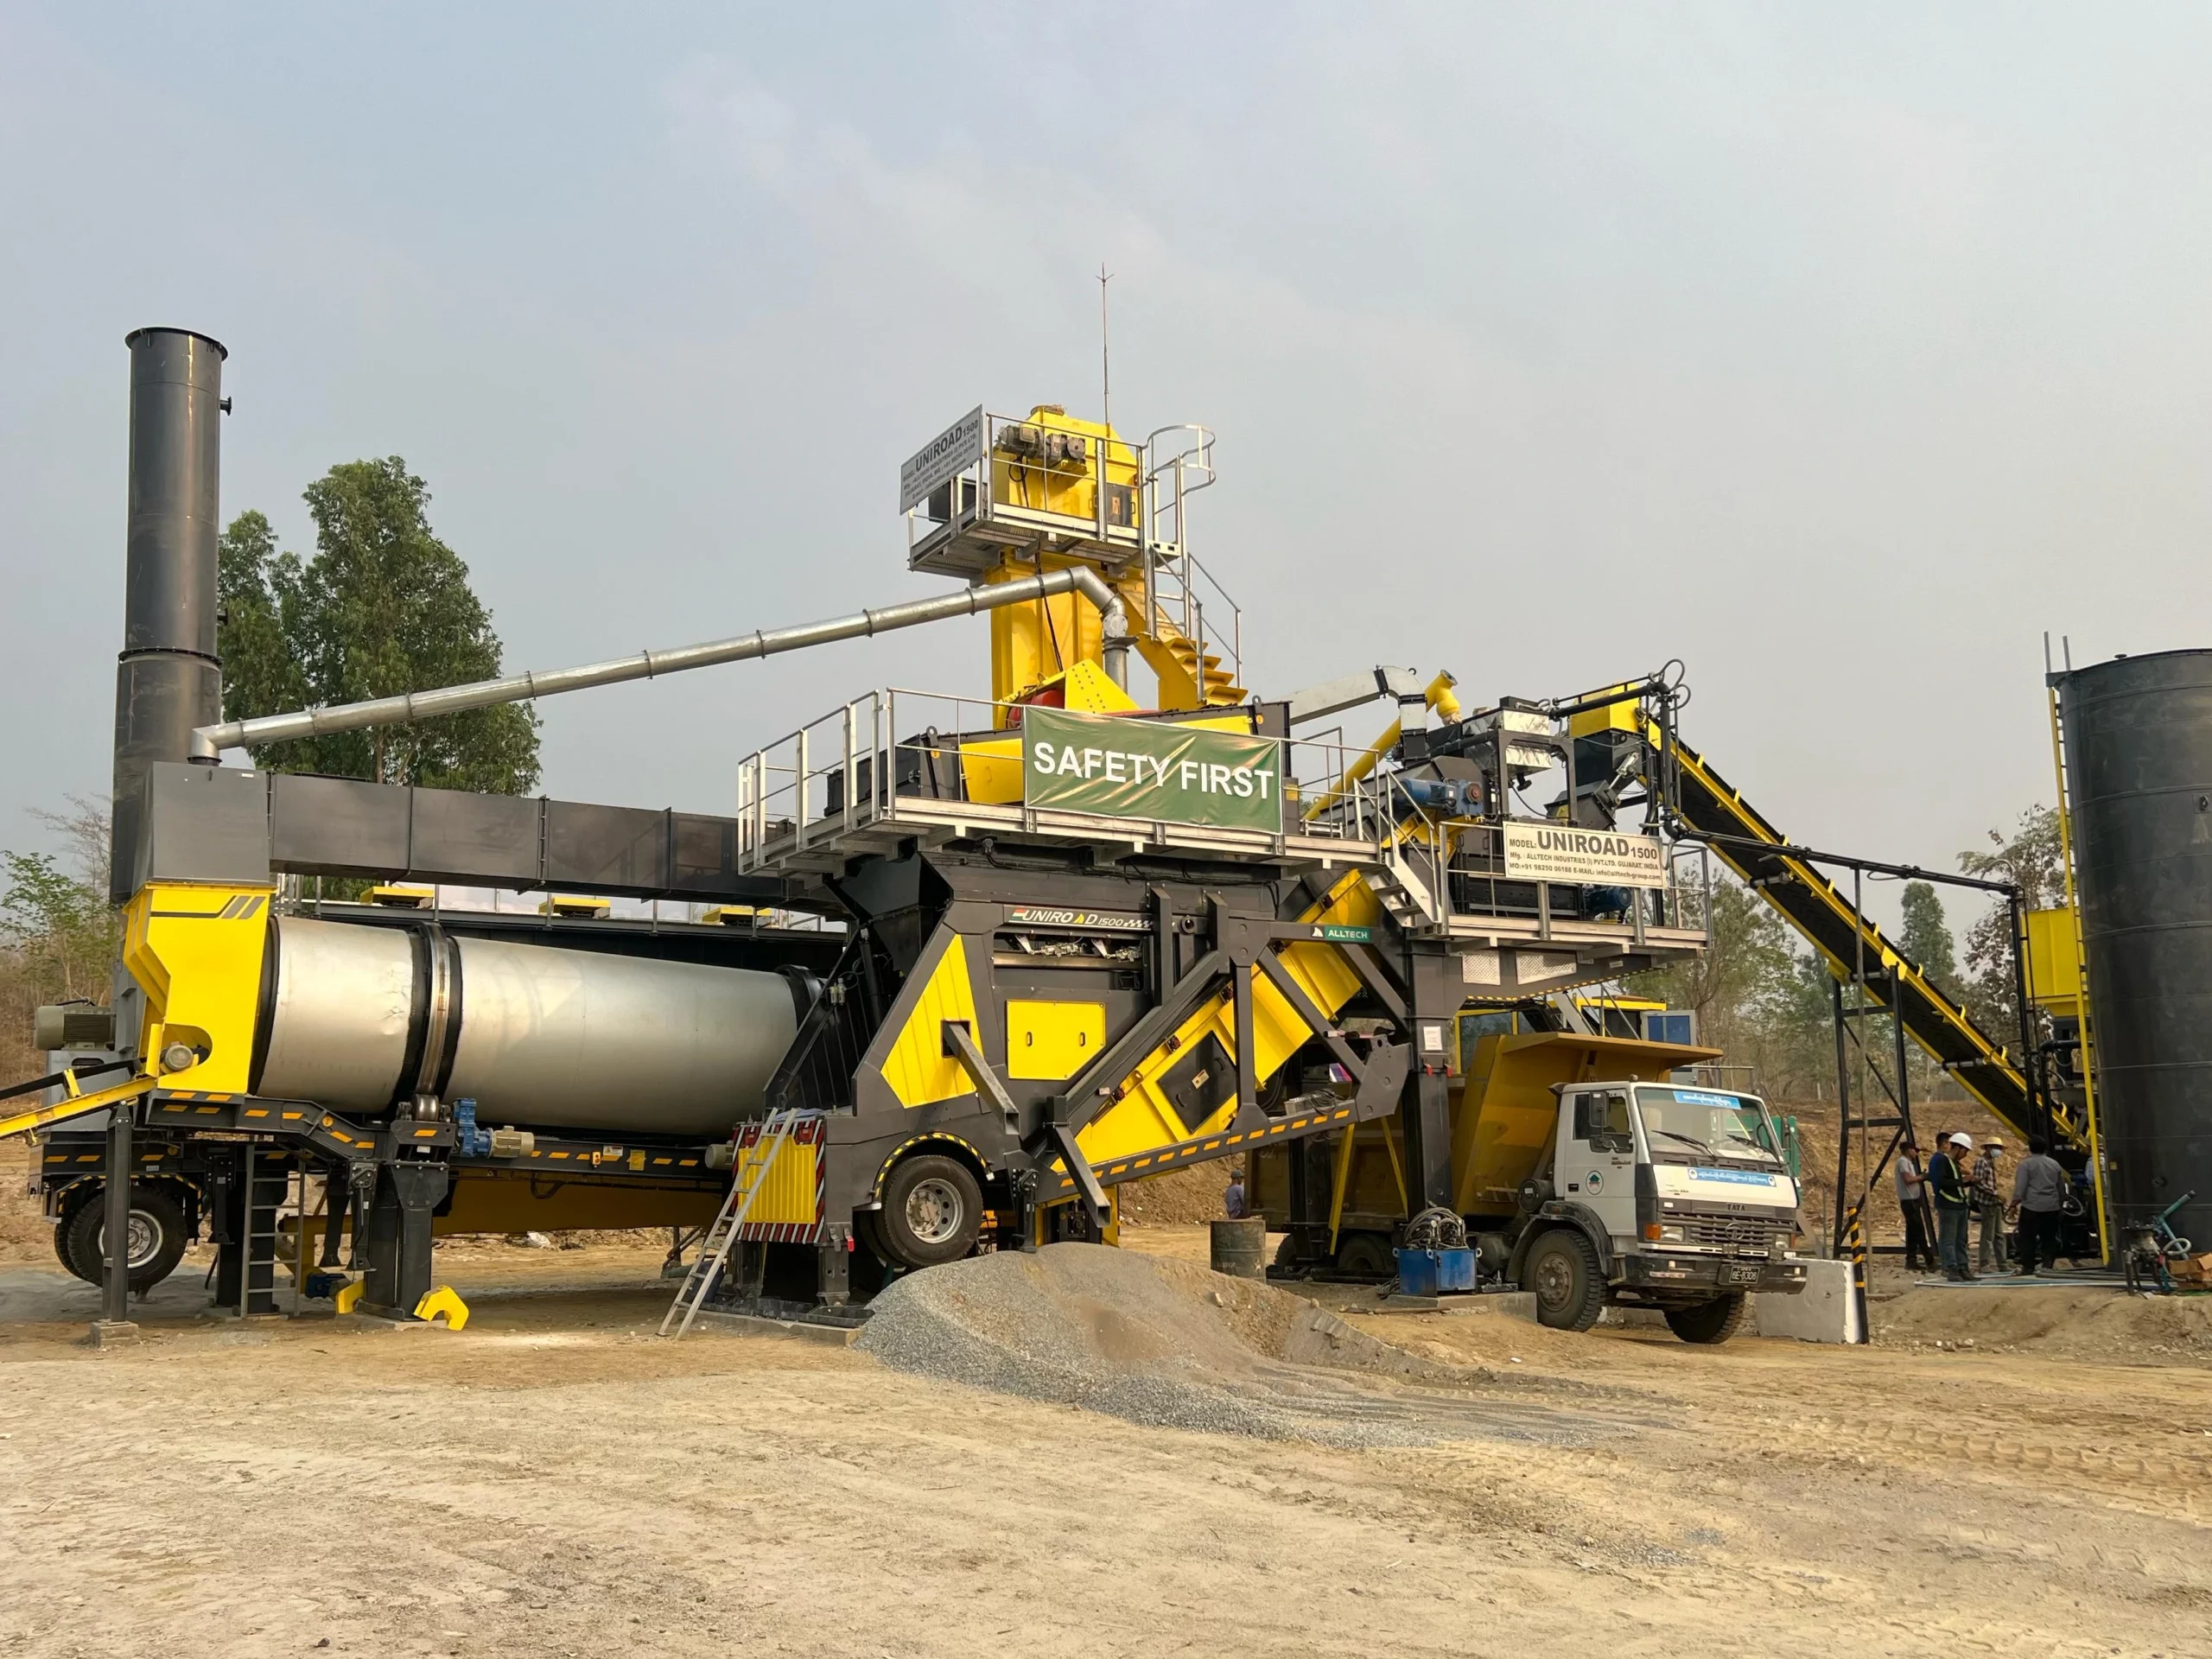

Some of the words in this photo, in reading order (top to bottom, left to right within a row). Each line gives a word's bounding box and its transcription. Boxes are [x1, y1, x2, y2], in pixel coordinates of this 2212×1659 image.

[916, 426, 963, 472] UNIROAD
[963, 419, 978, 437] 1500
[1033, 741, 1170, 787] SAFETY
[1180, 760, 1274, 799] FIRST
[1509, 838, 1536, 848] MODEL:
[1537, 830, 1629, 856] UNIROAD
[1630, 846, 1656, 859] 1500
[1554, 855, 1586, 863] INDUSTRIES
[1097, 918, 1123, 926] 1500
[1328, 929, 1368, 939] ALLTECH
